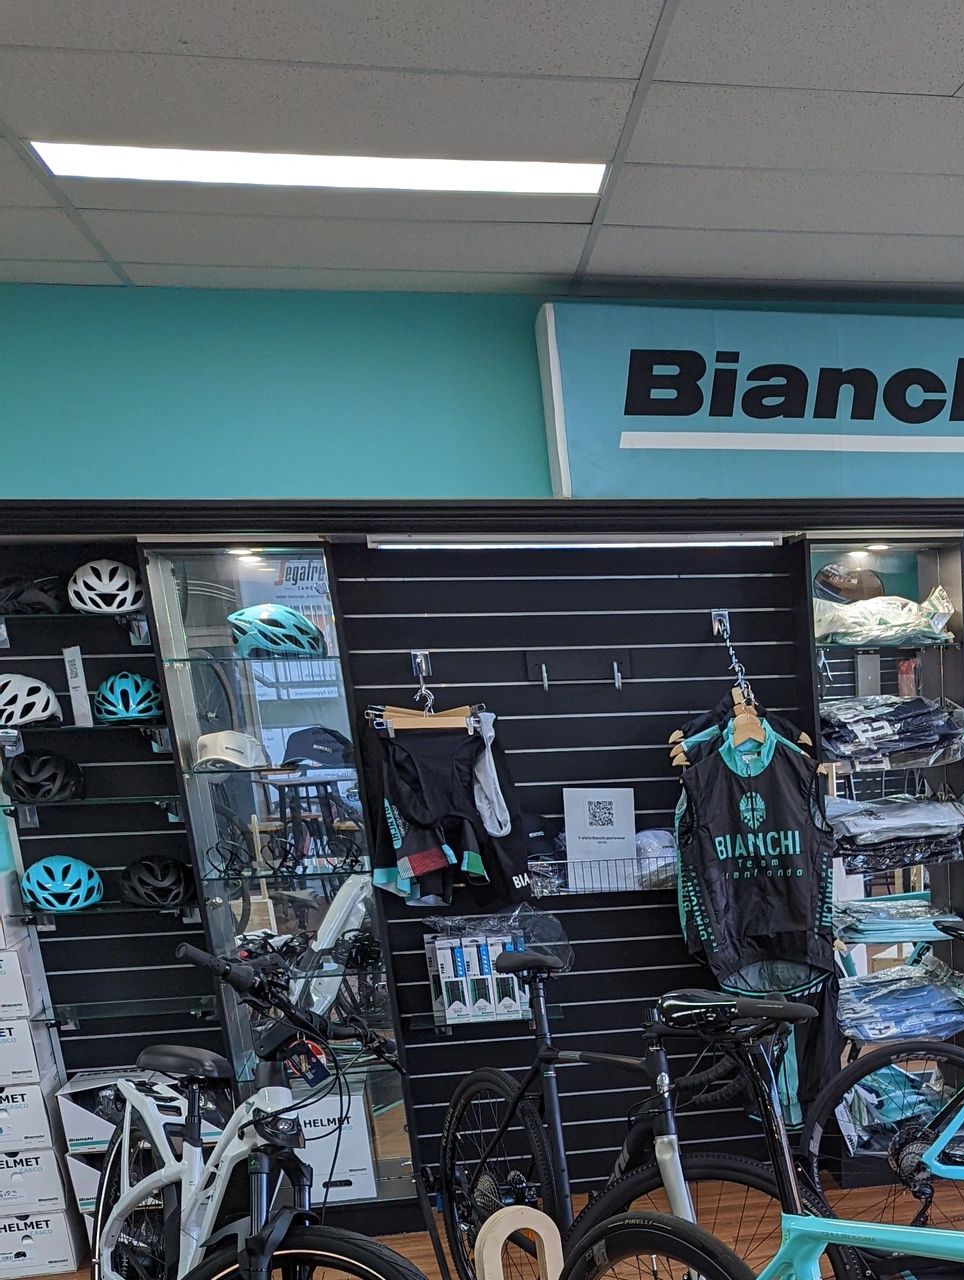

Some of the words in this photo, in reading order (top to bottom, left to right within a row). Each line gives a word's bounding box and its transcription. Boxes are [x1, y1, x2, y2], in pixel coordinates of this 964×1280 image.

[714, 830, 801, 861] BIANCHI
[738, 859, 779, 867] Team
[0, 1219, 51, 1233] HELMET
[624, 1218, 653, 1226] PIRELLI
